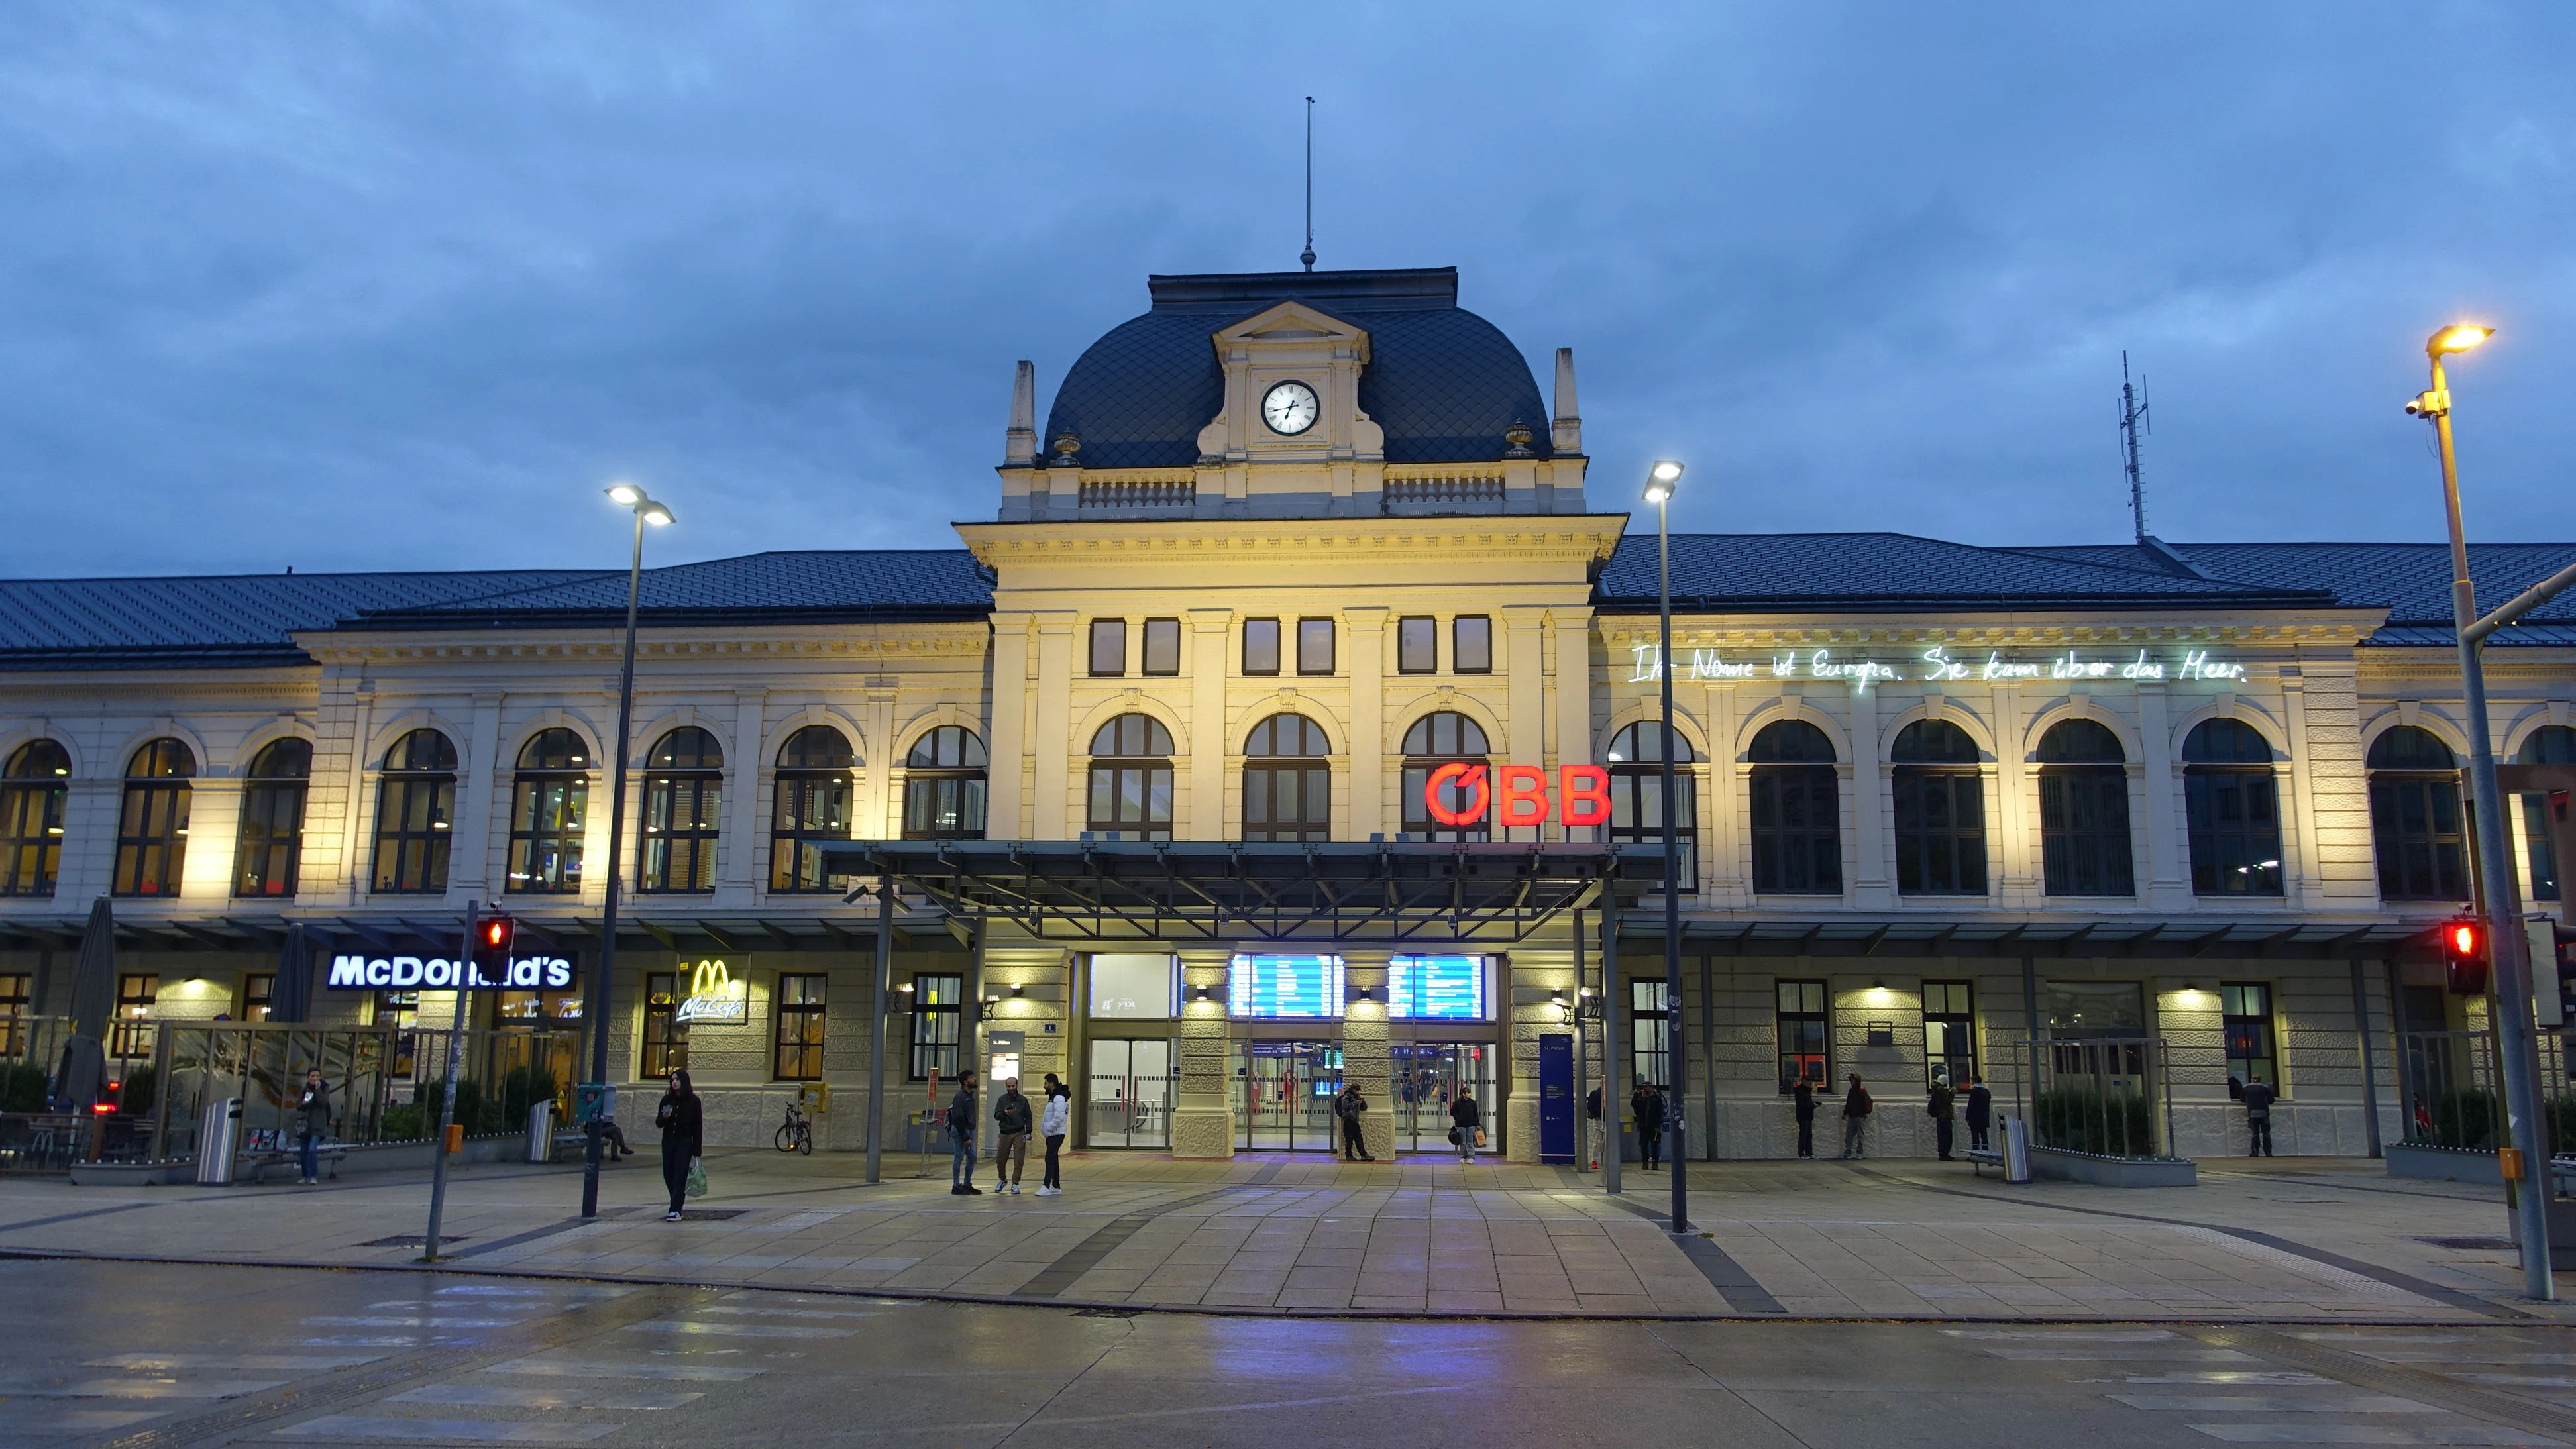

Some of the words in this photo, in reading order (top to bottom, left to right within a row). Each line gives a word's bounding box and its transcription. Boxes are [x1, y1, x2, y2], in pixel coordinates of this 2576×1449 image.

[1691, 648, 1754, 680] Name
[1772, 651, 1796, 676] ist
[1813, 650, 1902, 694] Europa.
[1923, 646, 1969, 681] Sie
[1983, 651, 2039, 680] kam
[2053, 650, 2114, 679] über
[2123, 649, 2163, 679] das
[2179, 650, 2247, 683] Meer.
[1426, 763, 1611, 826] ÖBB
